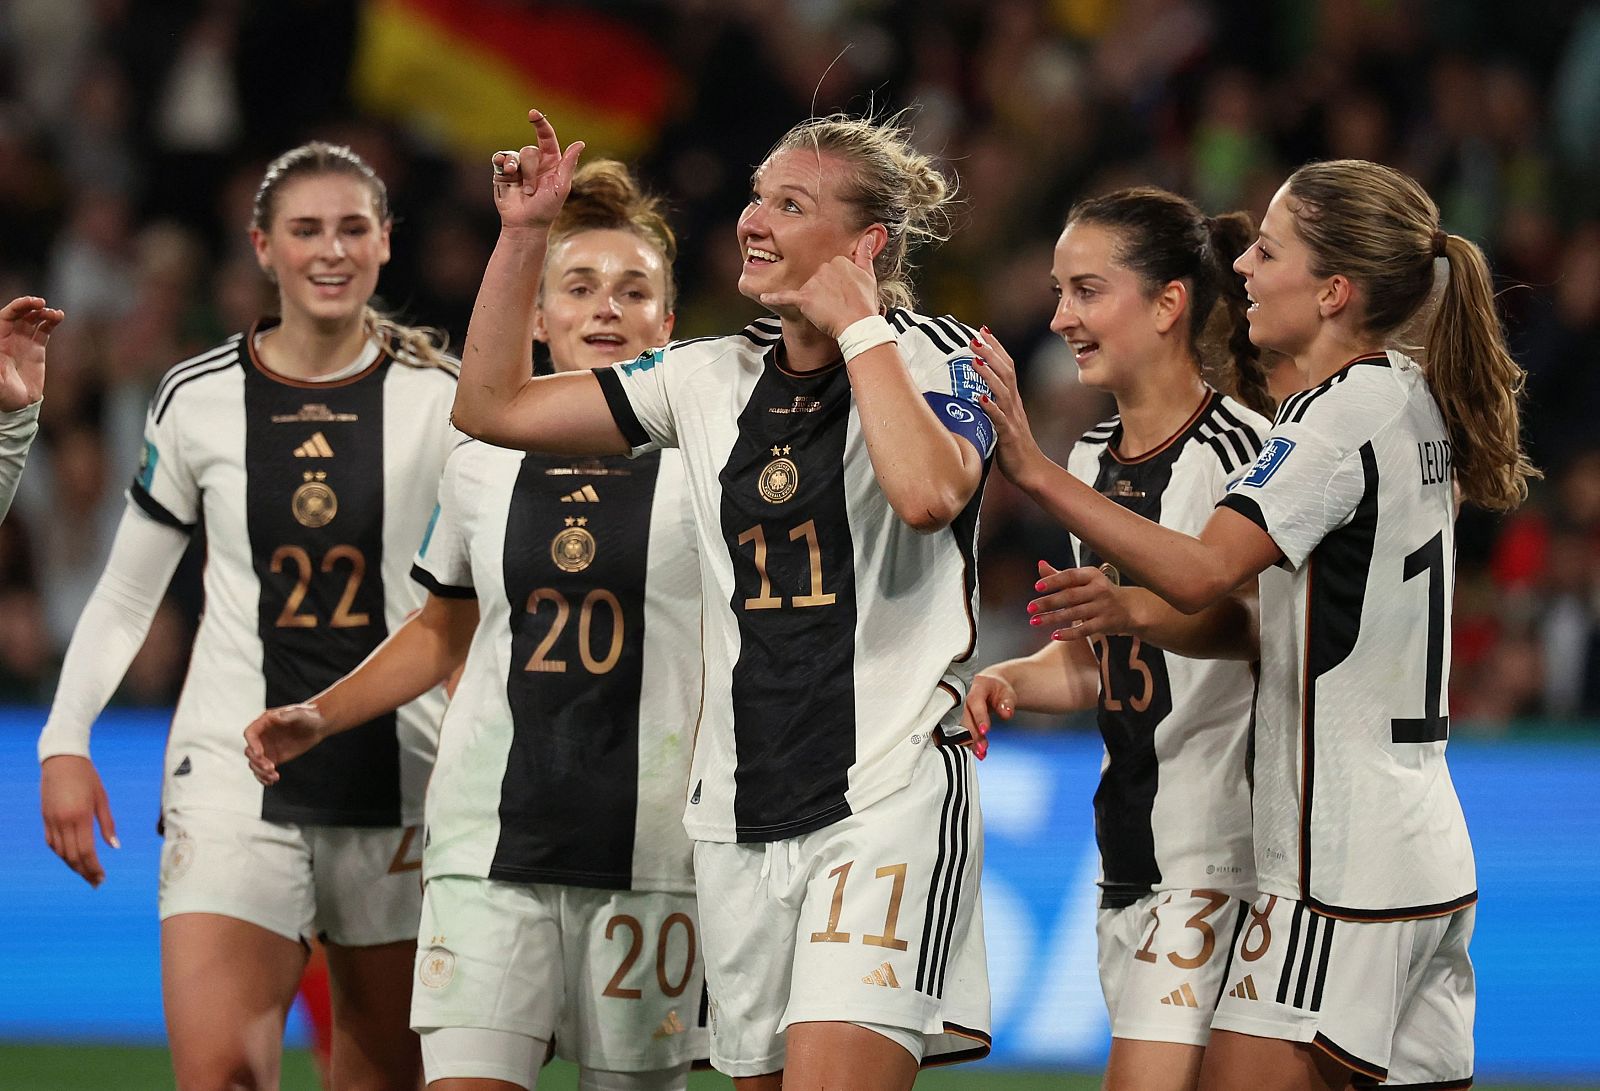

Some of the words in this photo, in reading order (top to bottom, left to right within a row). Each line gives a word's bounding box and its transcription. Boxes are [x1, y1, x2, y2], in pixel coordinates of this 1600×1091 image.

[1417, 439, 1453, 486] LEUP
[269, 544, 370, 629] 22
[737, 518, 837, 611] 11
[523, 587, 625, 675] 20
[1087, 632, 1154, 713] 13
[809, 859, 909, 953] 11
[1133, 889, 1231, 970] 13
[601, 912, 697, 1000] 20
